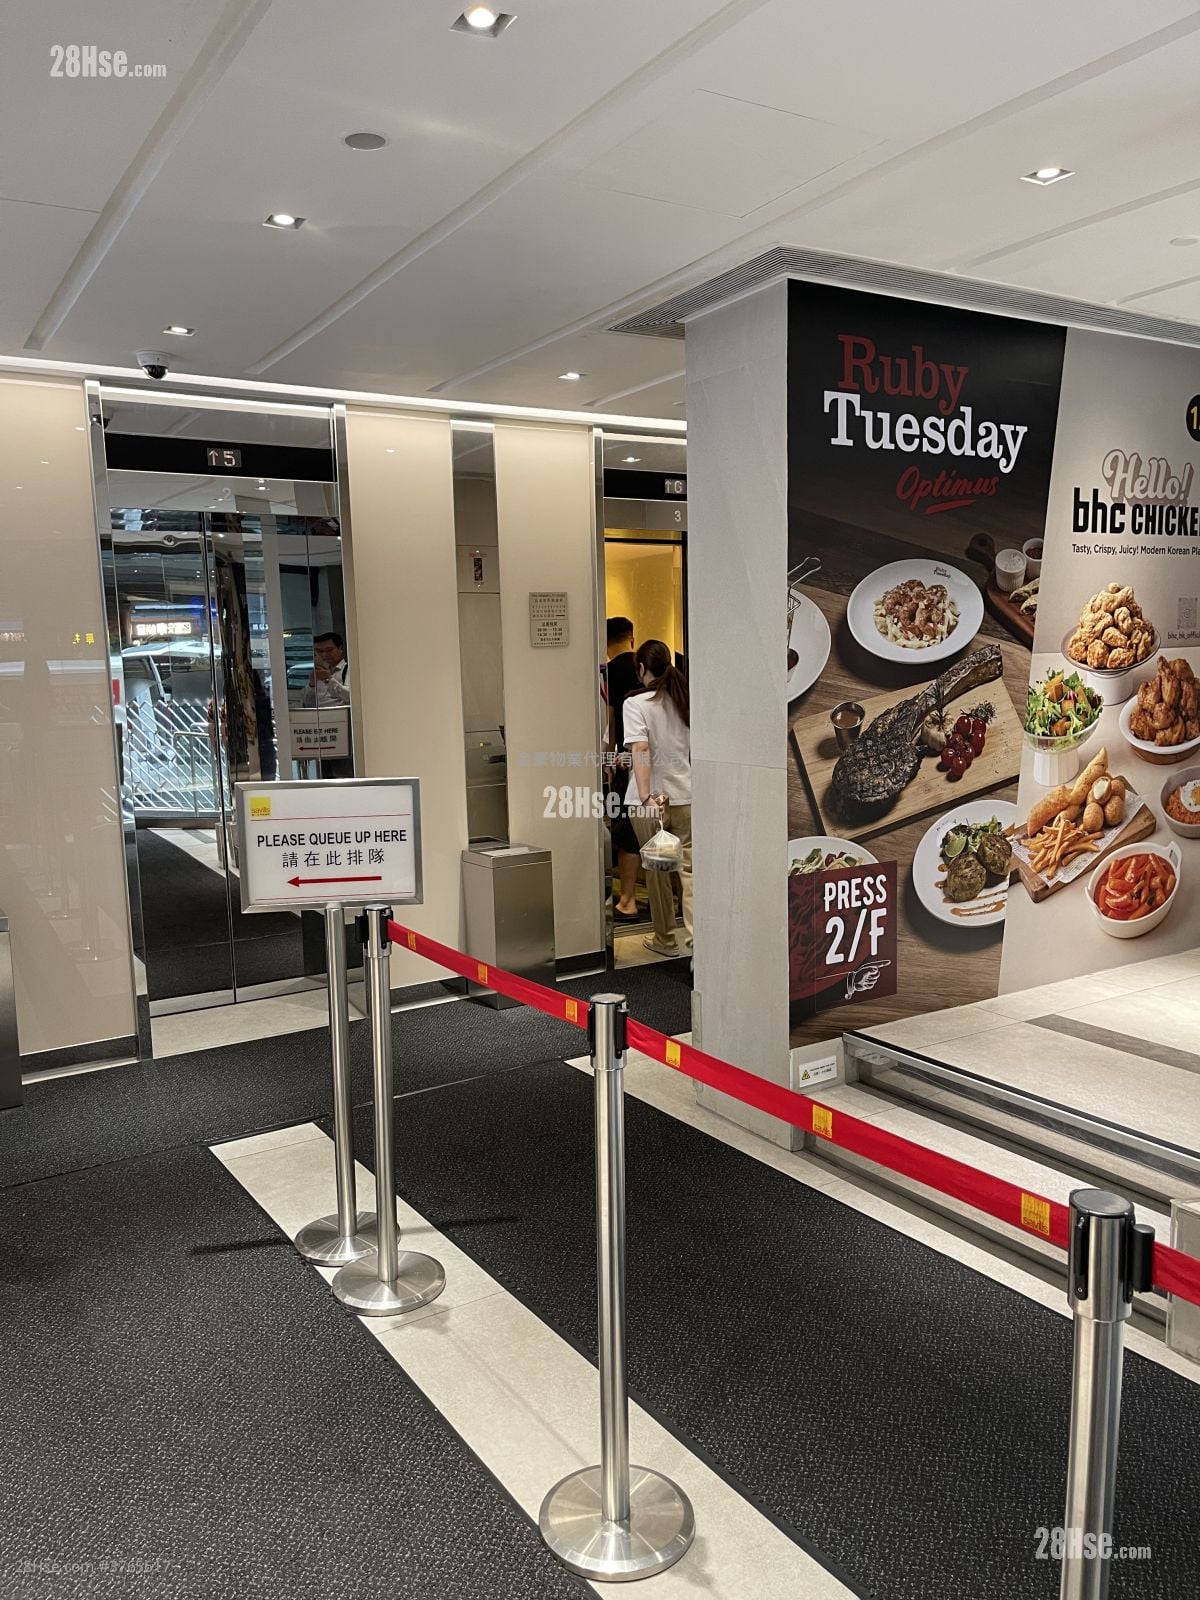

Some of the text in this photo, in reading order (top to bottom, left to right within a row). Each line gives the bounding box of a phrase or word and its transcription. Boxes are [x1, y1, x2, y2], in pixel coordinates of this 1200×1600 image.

[837, 334, 969, 416] Ruby
[823, 390, 1028, 474] Tuesday
[895, 465, 999, 510] Optimus
[1102, 448, 1195, 506] Hello!
[674, 510, 682, 522] 3
[1072, 487, 1200, 537] bhc CHICKE
[1072, 543, 1092, 554] Tasty,
[1093, 544, 1118, 555] Crispy,
[1118, 545, 1139, 556] Juicy!
[1140, 546, 1166, 555] Modern
[1167, 546, 1190, 555] Korean
[257, 829, 407, 848] PLEASE QUEUE UP HERE
[281, 848, 385, 868] 請在此排隊
[823, 874, 887, 912] PRESS
[825, 907, 888, 965] 2/F
